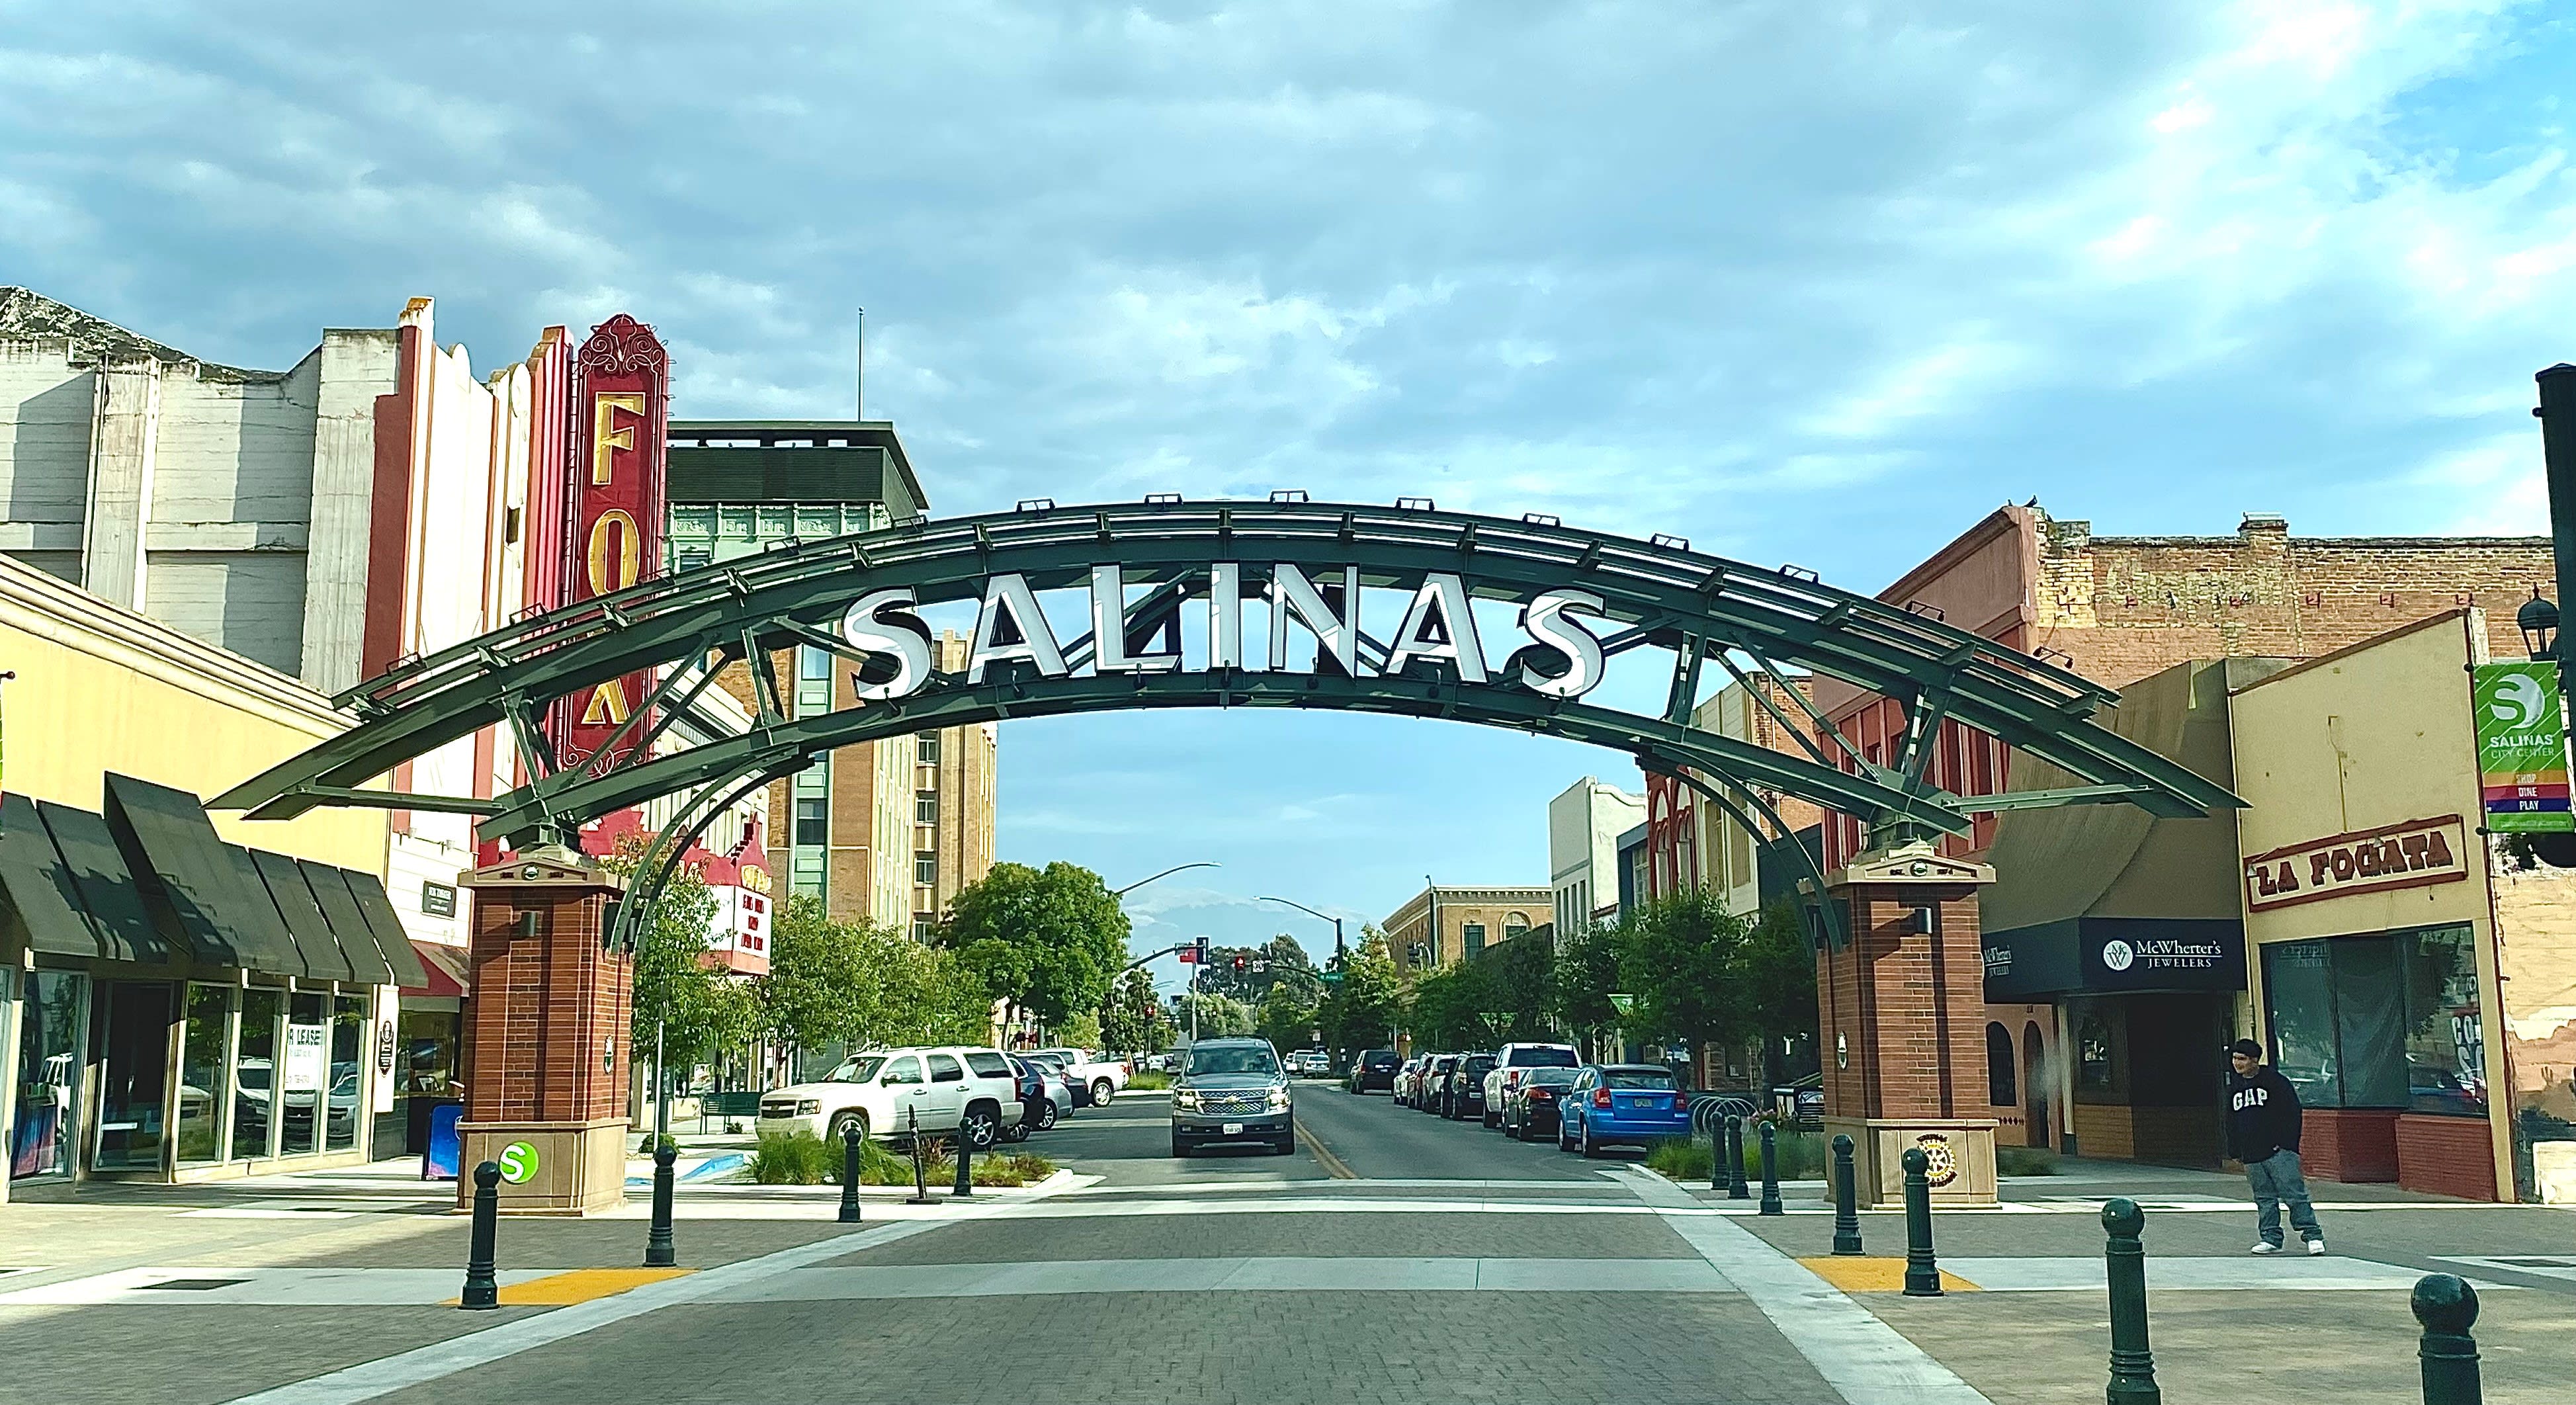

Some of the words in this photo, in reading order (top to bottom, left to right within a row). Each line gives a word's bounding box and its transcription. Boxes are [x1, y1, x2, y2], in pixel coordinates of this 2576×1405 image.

[841, 561, 1608, 702] SALINAS
[2489, 734, 2554, 747] SALINAS
[2491, 749, 2513, 759] CITY
[2516, 747, 2555, 757] CENTER
[2516, 773, 2538, 784] SHOP
[2518, 787, 2538, 797] DINE
[2519, 800, 2540, 810] PLAY
[2256, 861, 2300, 897] LA
[2309, 830, 2454, 887] FOGATA
[2135, 939, 2221, 955] McWherter's
[2147, 958, 2211, 969] JEWELERS
[296, 1029, 321, 1046] LEASE
[2233, 1087, 2268, 1111] GAP
